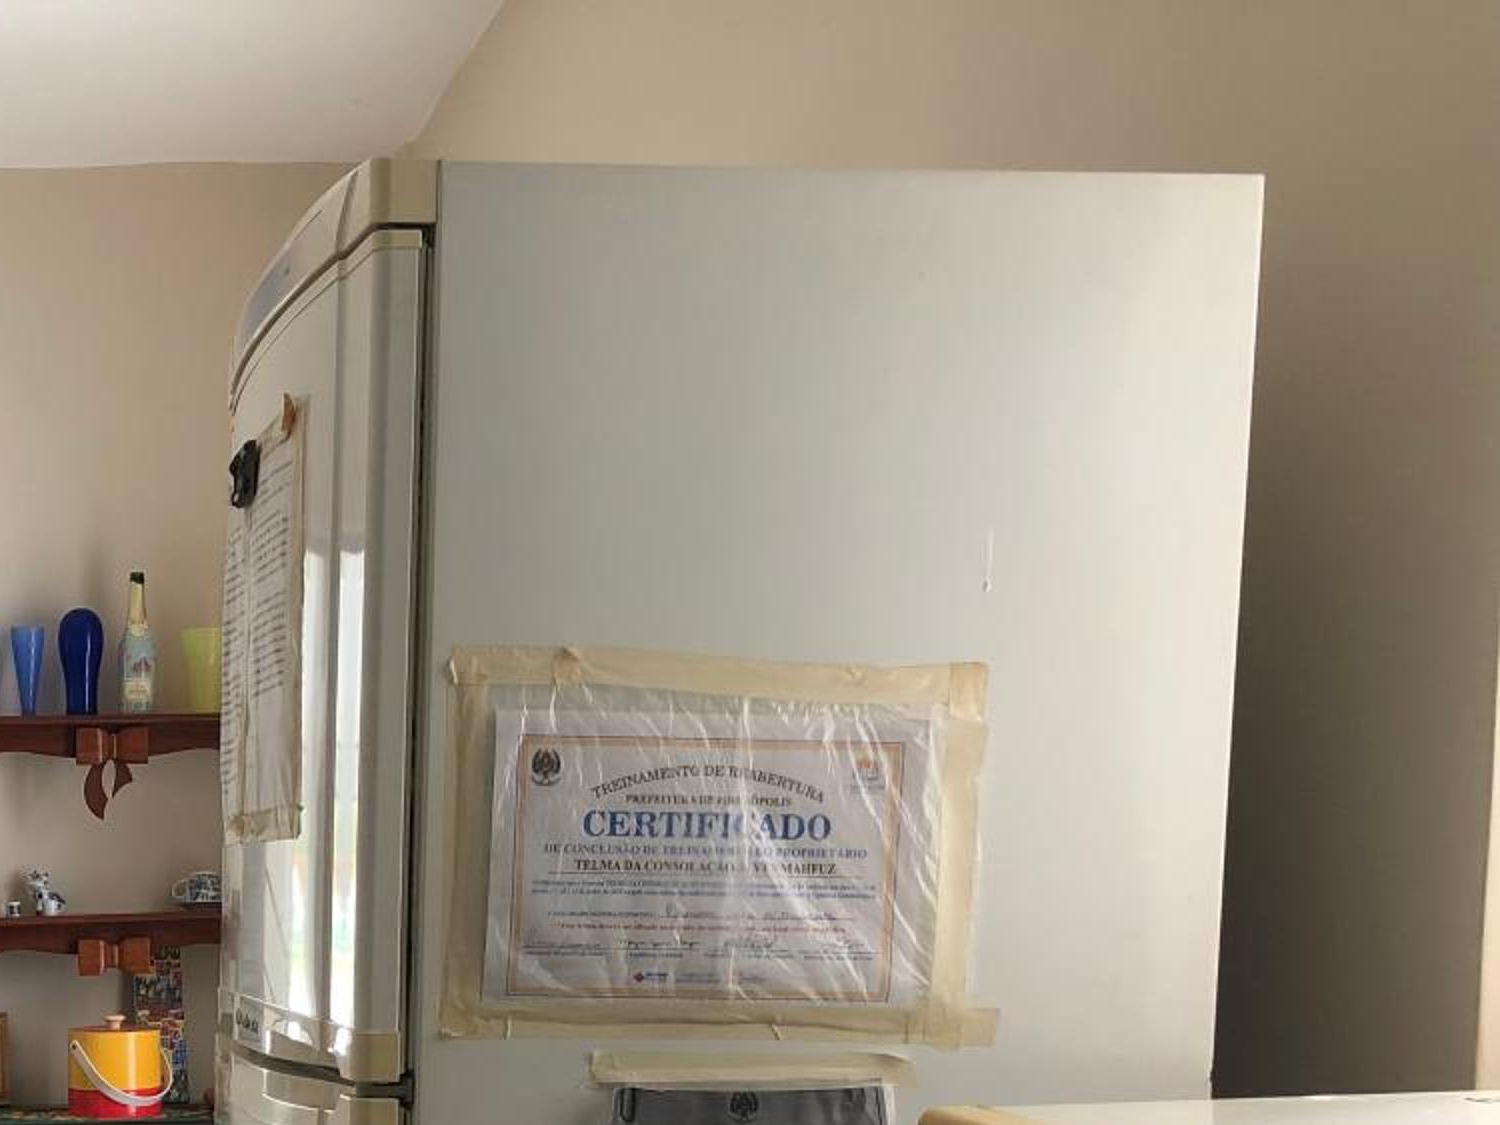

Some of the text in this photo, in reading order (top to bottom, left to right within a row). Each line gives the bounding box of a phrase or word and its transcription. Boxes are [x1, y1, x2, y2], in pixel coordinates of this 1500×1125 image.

[590, 765, 824, 804] TREINAMENTO DE RABERTURA
